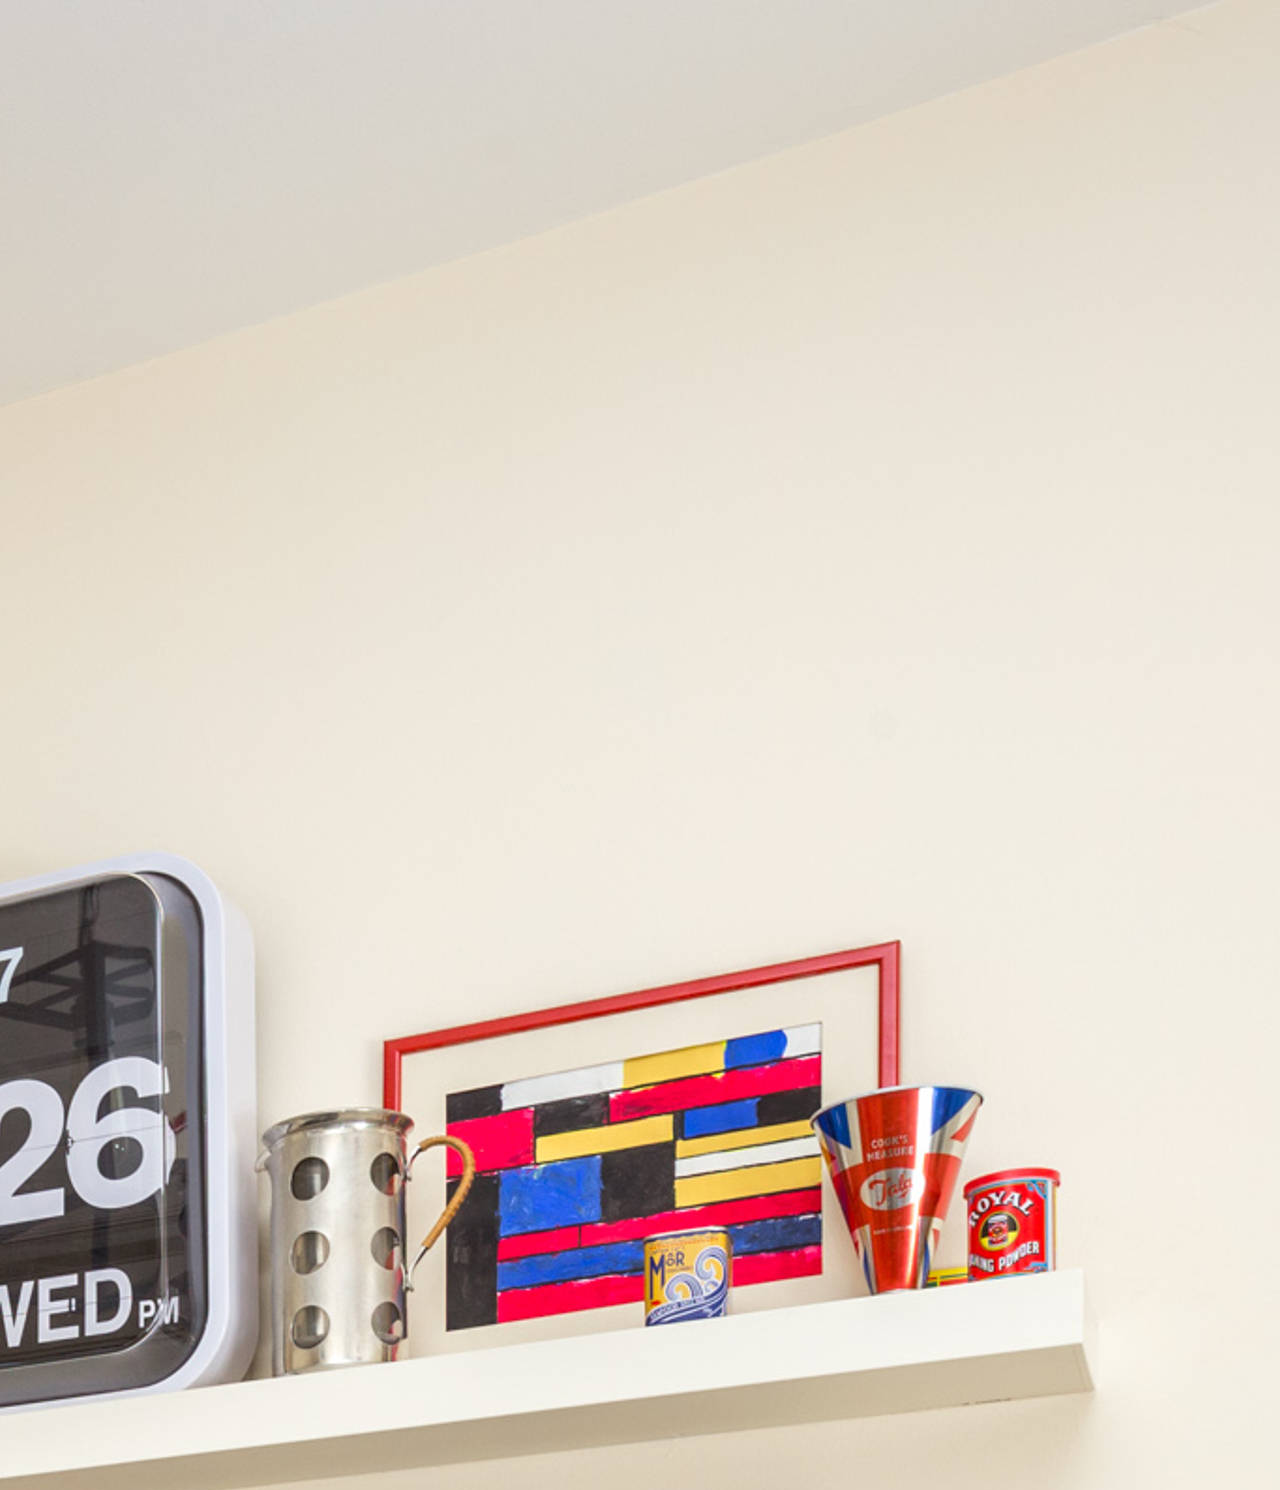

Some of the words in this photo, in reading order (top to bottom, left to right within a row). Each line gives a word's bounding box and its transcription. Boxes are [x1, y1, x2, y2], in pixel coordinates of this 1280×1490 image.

[871, 1134, 909, 1149] COOK'S
[866, 1145, 915, 1162] MEASURE
[999, 1241, 1040, 1271] POWDER
[139, 1296, 180, 1329] PM
